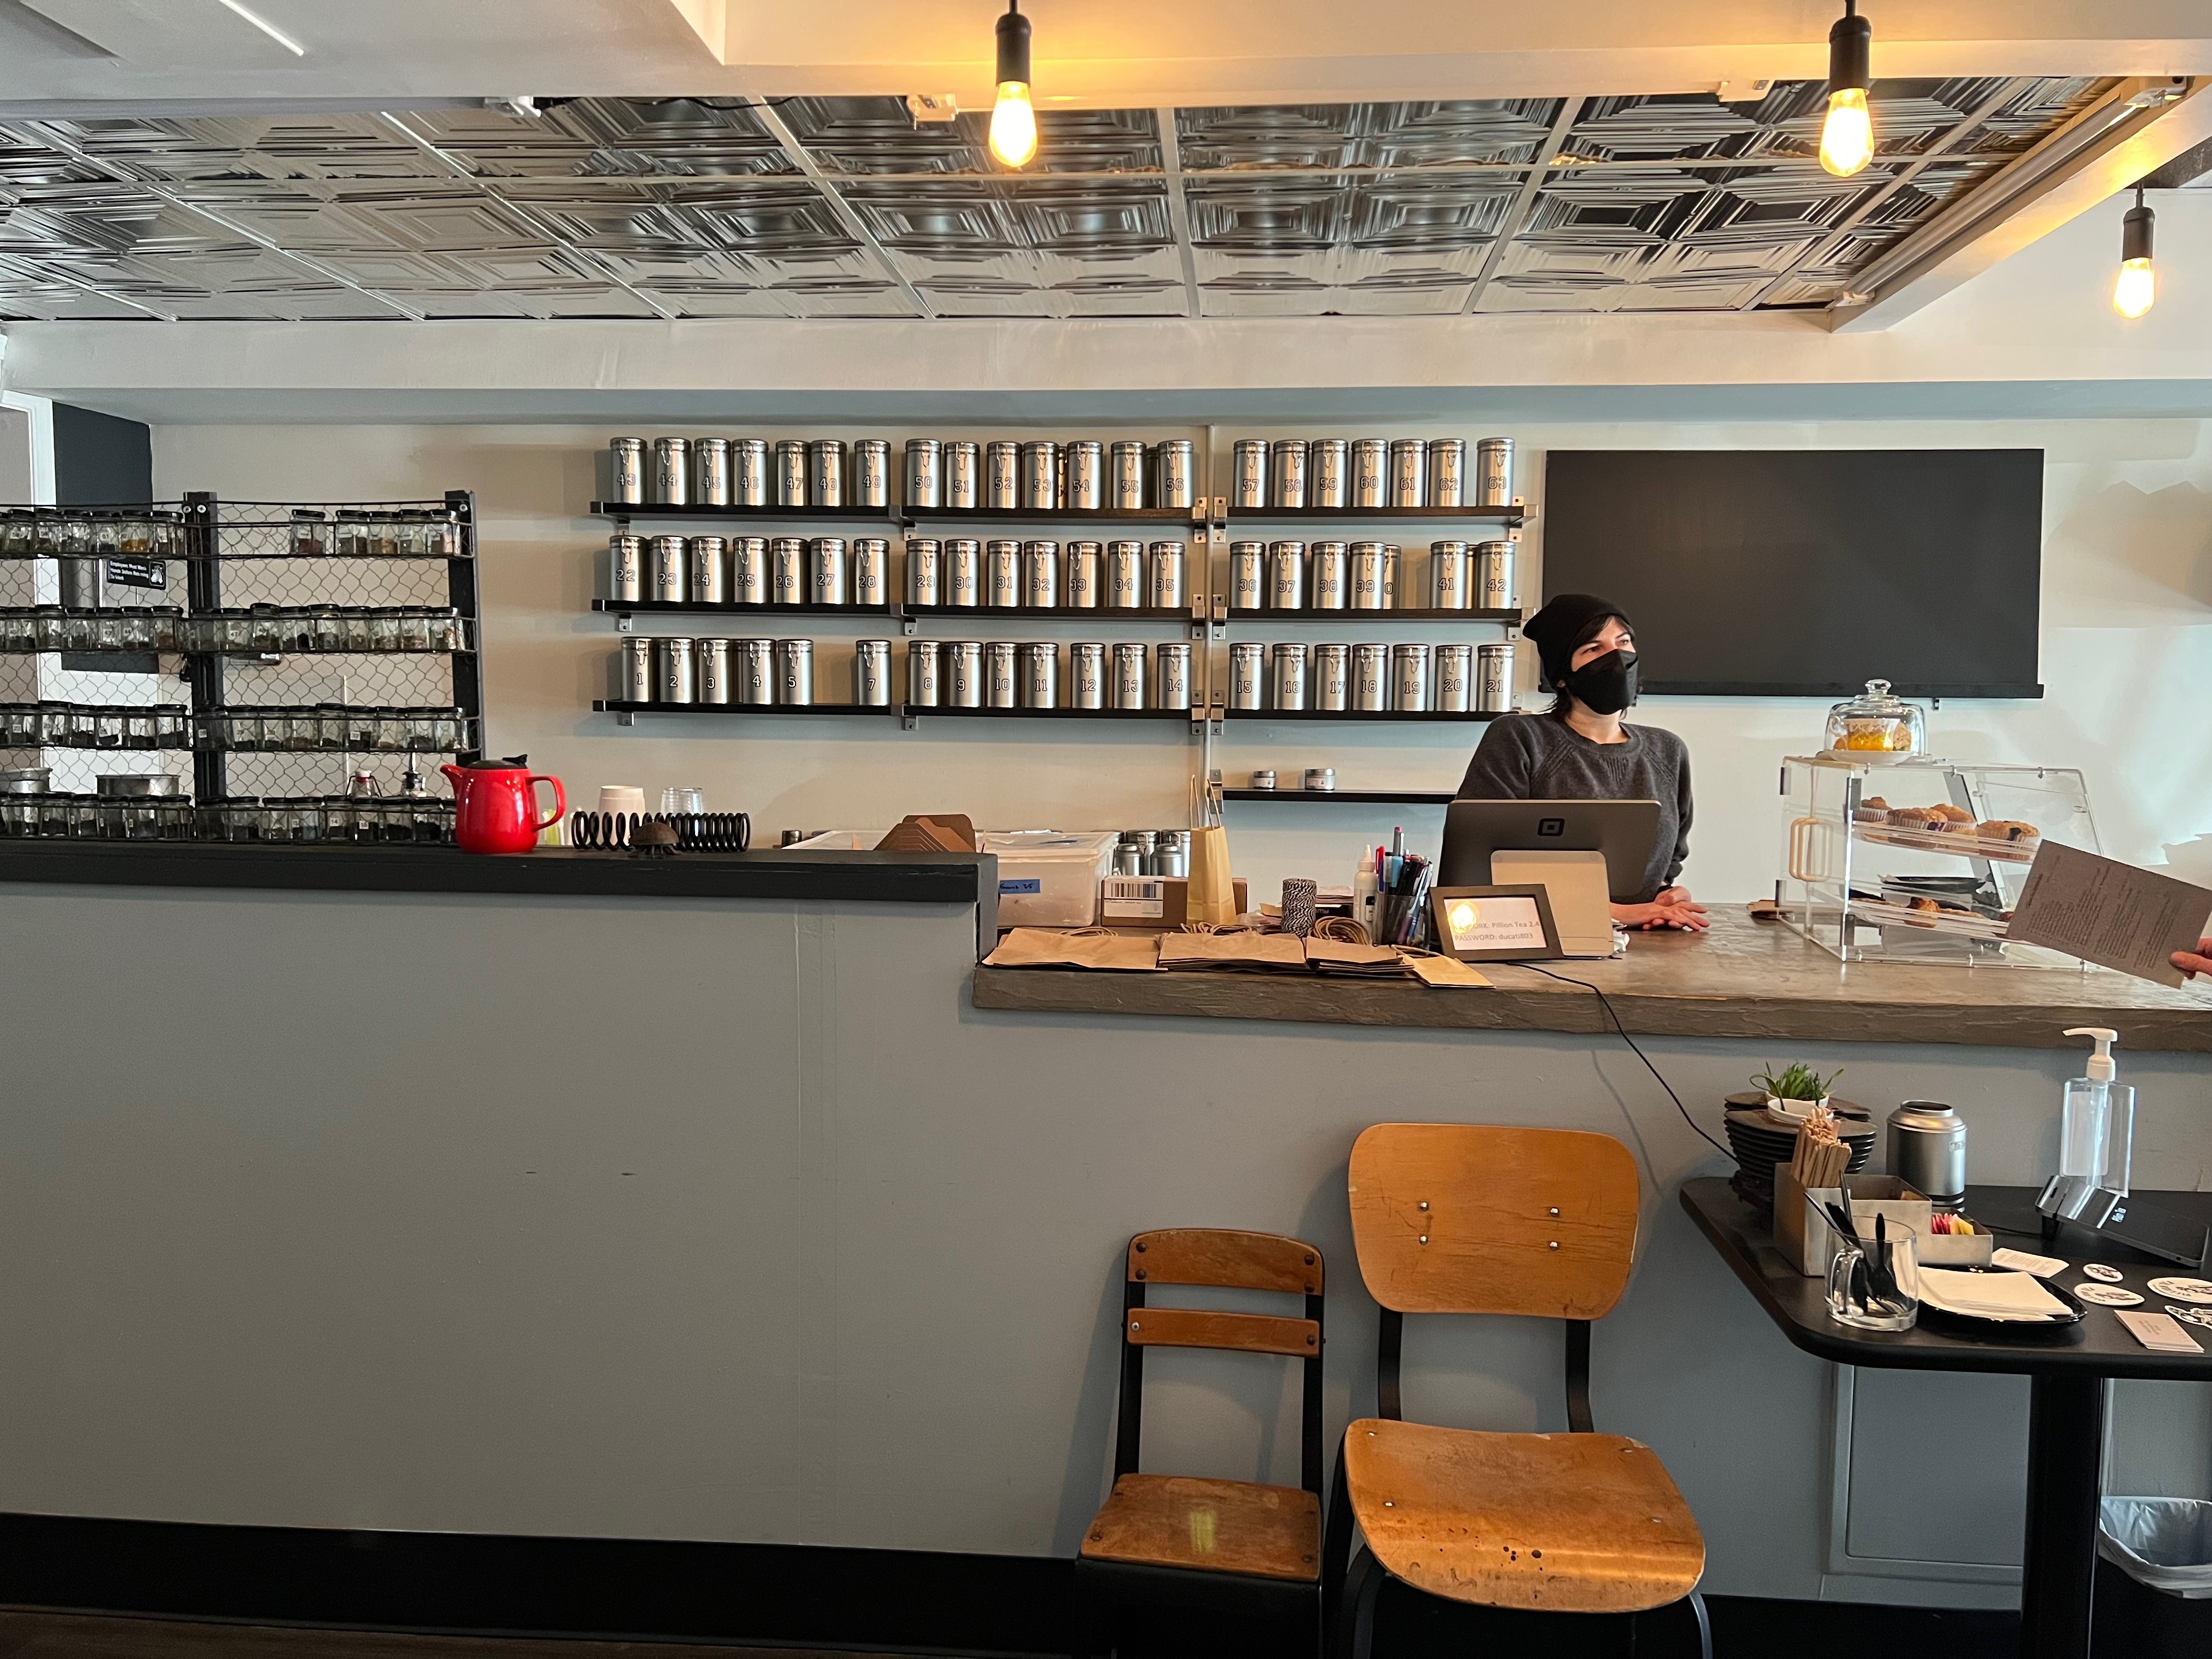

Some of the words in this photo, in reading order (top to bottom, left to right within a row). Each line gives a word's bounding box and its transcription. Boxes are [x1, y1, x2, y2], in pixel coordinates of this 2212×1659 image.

[617, 473, 636, 486] 43
[659, 473, 677, 486] 44
[702, 476, 721, 489] 45
[741, 476, 759, 489] 46
[786, 477, 803, 489] 47
[819, 477, 837, 490] 48
[862, 475, 881, 488] 49
[915, 476, 933, 489] 50
[994, 477, 1013, 490] 52
[1033, 478, 1052, 492] 53
[1072, 479, 1090, 493] 54
[1121, 479, 1139, 493] 55
[1166, 478, 1184, 491] 56
[1243, 478, 1260, 492] 57
[1284, 479, 1302, 492] 58
[1319, 477, 1338, 490] 59
[1359, 476, 1379, 489] 60
[1400, 477, 1415, 490] 61
[1440, 477, 1458, 490] 62
[1488, 476, 1507, 489] 63
[953, 480, 969, 493] 51
[616, 569, 636, 582] 22
[658, 572, 676, 585] 23
[693, 573, 710, 586] 24
[737, 573, 755, 586] 25
[776, 575, 793, 588] 26
[816, 573, 835, 586] 27
[859, 575, 876, 588] 28
[916, 574, 935, 588] 29
[955, 576, 973, 589] 30
[997, 576, 1012, 589] 31
[1032, 578, 1050, 591] 32
[1070, 578, 1086, 591] 33
[1115, 578, 1133, 591] 34
[1156, 578, 1174, 591] 35
[1238, 579, 1257, 592] 36
[1278, 579, 1295, 593] 37
[1319, 579, 1338, 592] 38
[1356, 579, 1374, 592] 39
[1438, 577, 1454, 590] 41
[1487, 578, 1506, 591] 42
[637, 672, 643, 685] 1
[669, 675, 678, 687] 2
[707, 677, 715, 689] 3
[752, 675, 761, 687] 4
[788, 675, 796, 688] 5
[868, 678, 876, 691] 7
[924, 677, 932, 690] 8
[957, 679, 966, 691] 9
[995, 678, 1010, 691] 10
[1168, 679, 1182, 691] 14
[1035, 679, 1047, 692] 11
[1081, 679, 1096, 692] 12
[1123, 680, 1139, 692] 13
[1237, 680, 1252, 693] 15
[1285, 681, 1300, 693] 16
[1330, 680, 1346, 693] 17
[1361, 680, 1377, 693] 18
[1404, 681, 1420, 694] 19
[1443, 679, 1463, 692] 20
[1486, 680, 1504, 692] 21
